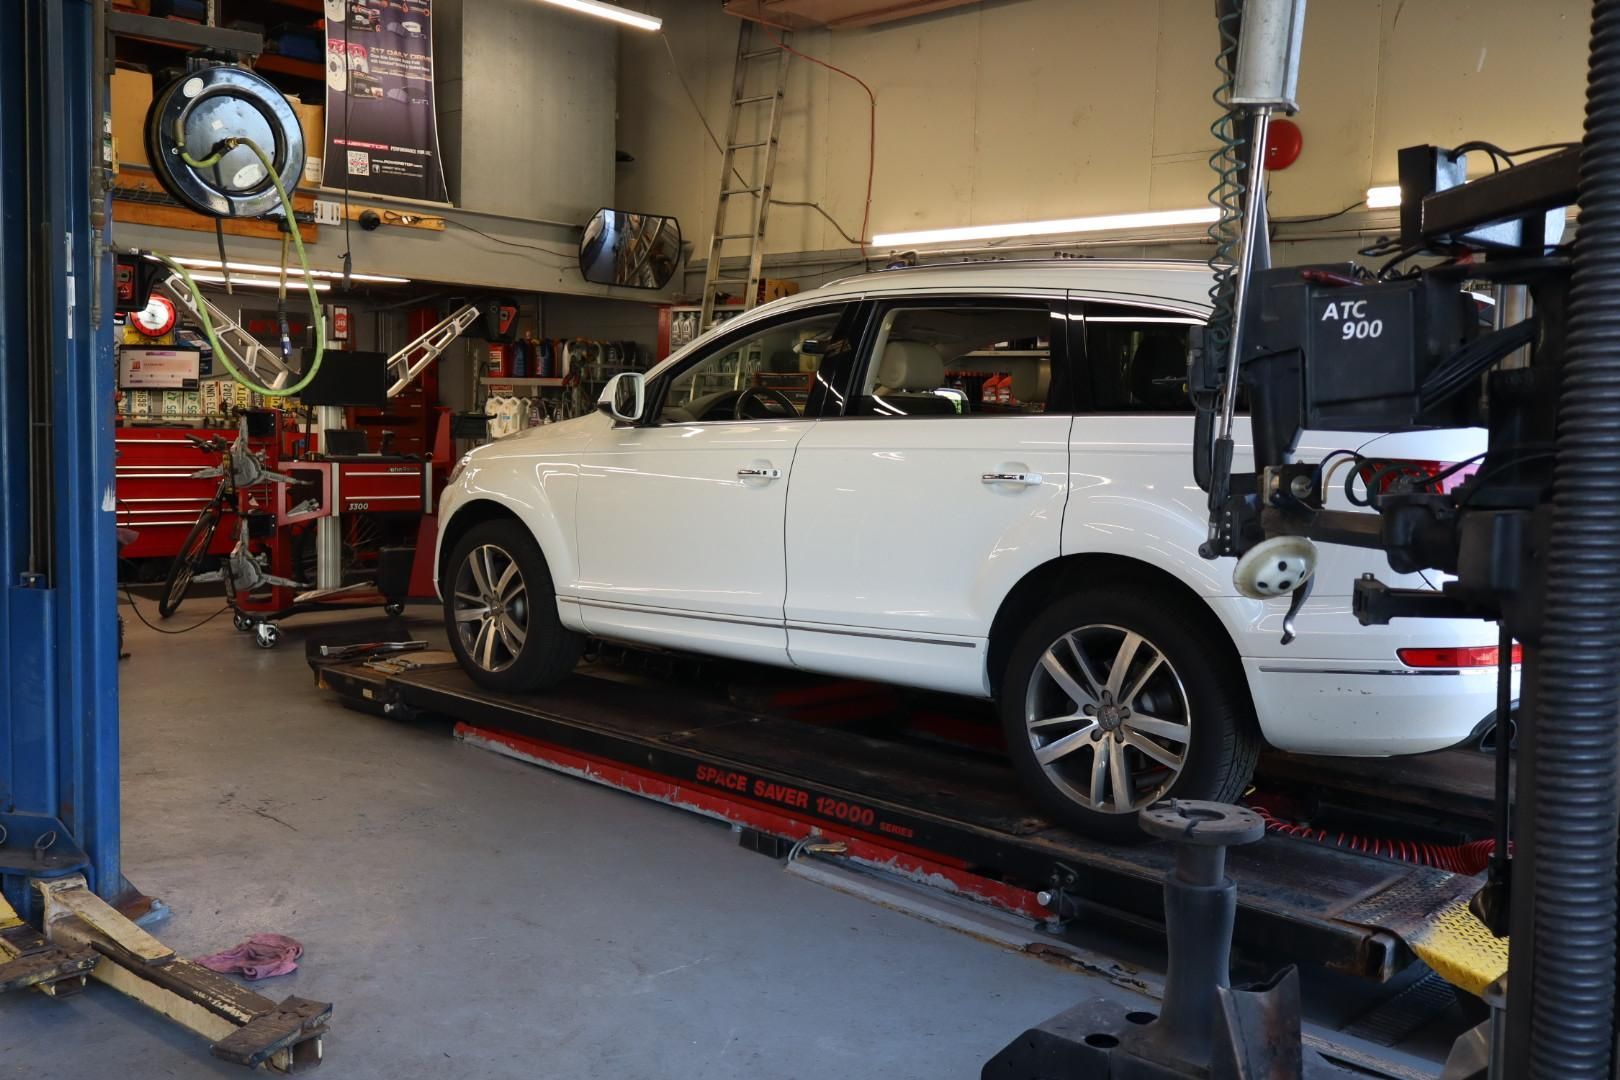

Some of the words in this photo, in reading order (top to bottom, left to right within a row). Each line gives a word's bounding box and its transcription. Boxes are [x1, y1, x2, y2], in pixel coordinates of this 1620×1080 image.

[1321, 300, 1367, 321] ATC
[1342, 319, 1383, 340] 900
[349, 503, 369, 511] 3300
[696, 764, 747, 791] SPACE
[753, 779, 809, 808] SAVER
[815, 797, 875, 826] 12000
[880, 821, 913, 838] SERIES
